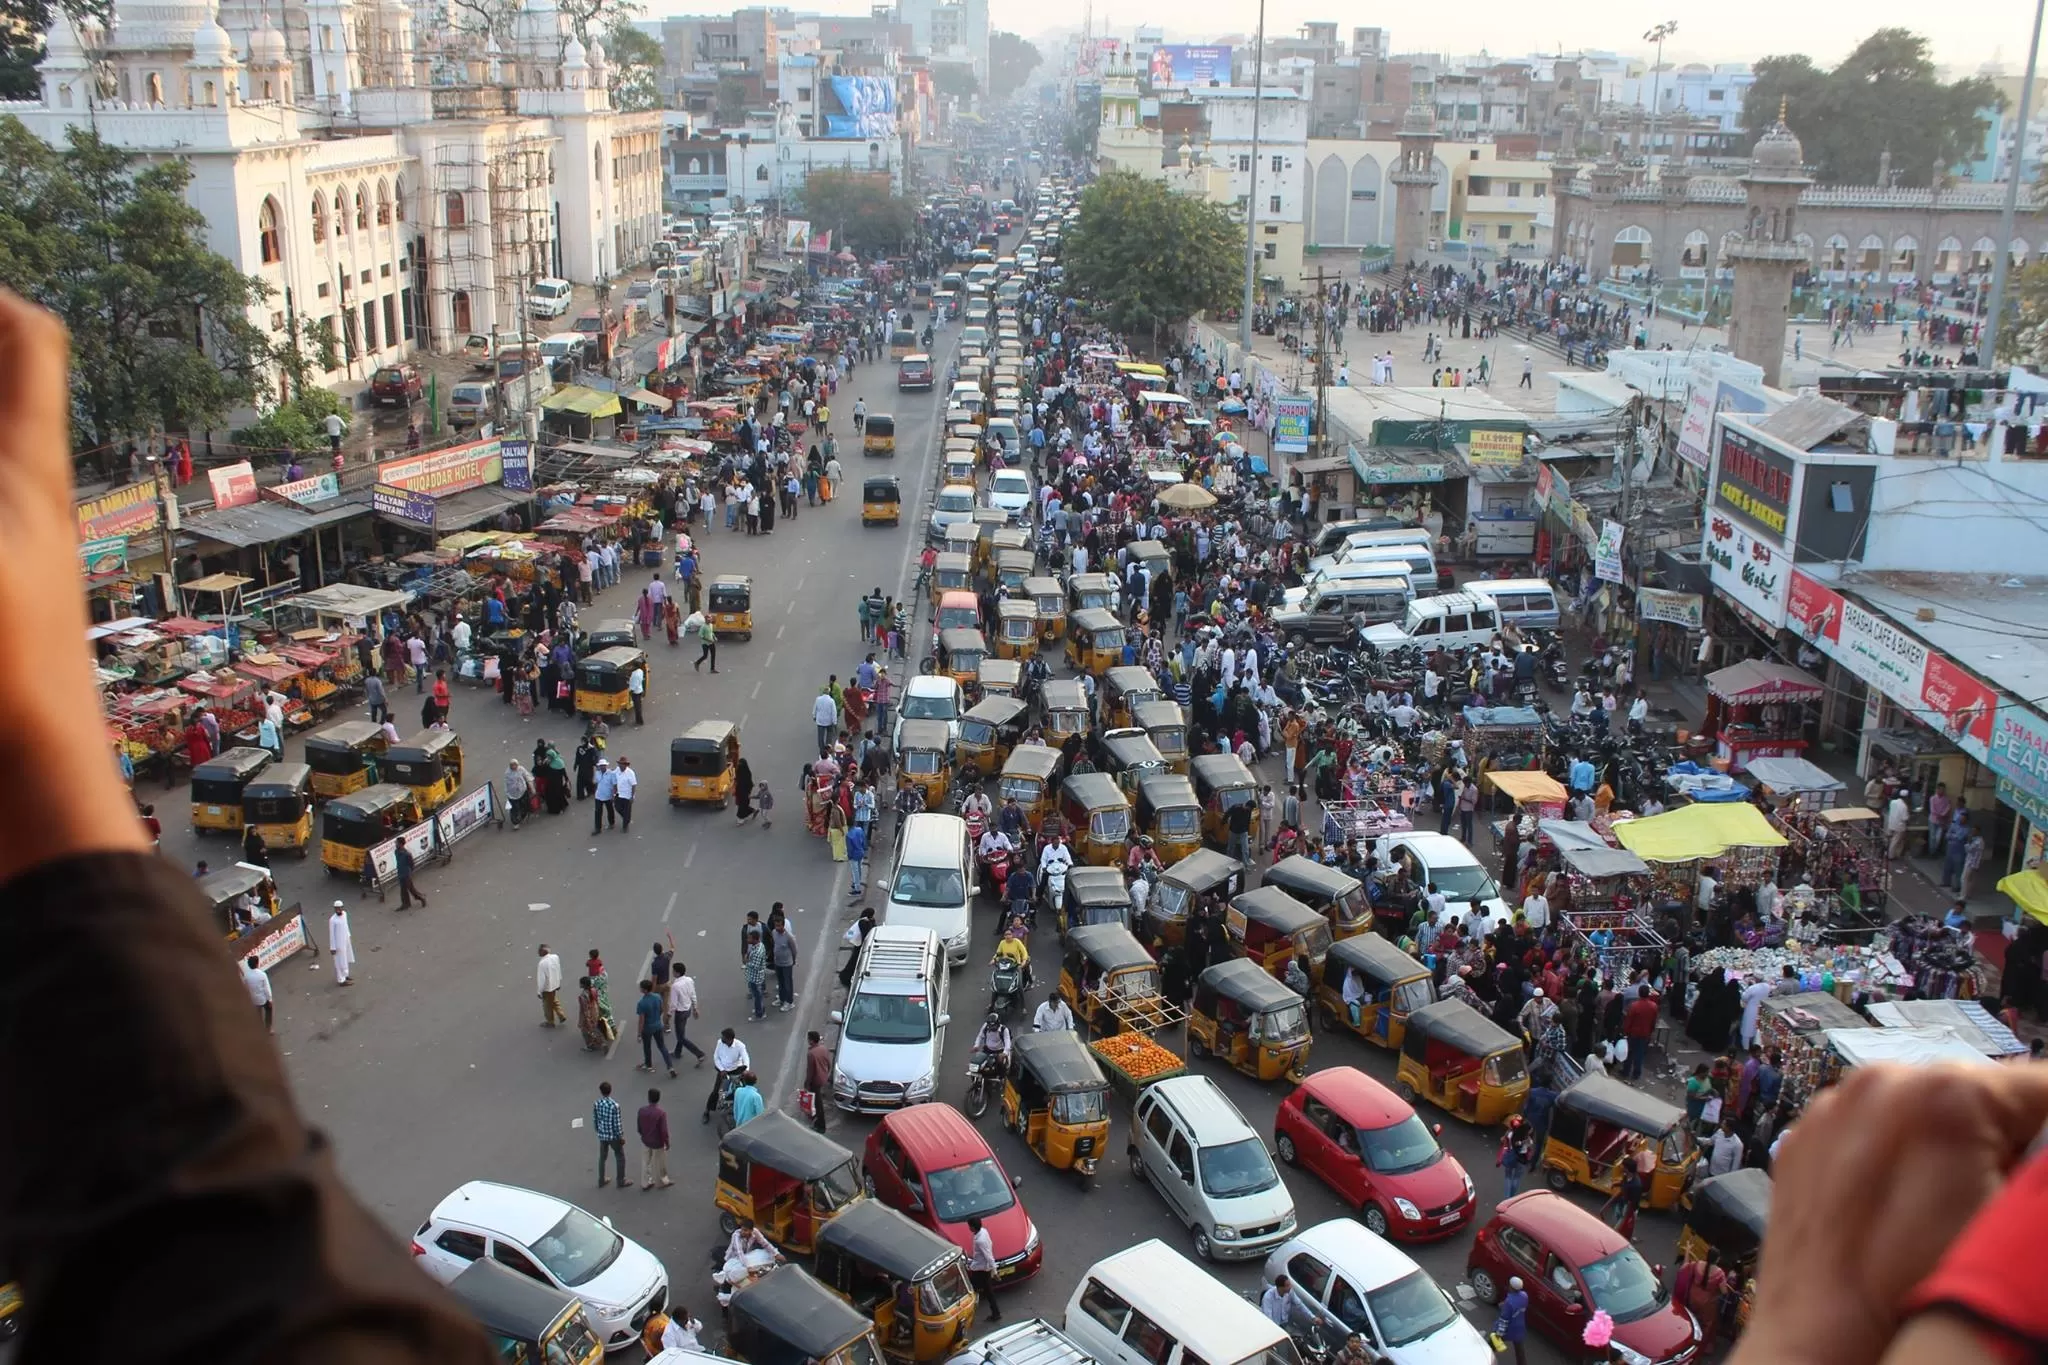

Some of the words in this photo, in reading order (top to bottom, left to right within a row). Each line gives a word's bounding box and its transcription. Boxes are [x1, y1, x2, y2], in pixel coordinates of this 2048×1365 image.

[501, 446, 527, 457] KALYANI
[503, 458, 527, 468] BIRYANI
[1723, 441, 1792, 505] NIMRAH
[406, 469, 452, 491] MUQADDAR
[455, 462, 481, 479] HOTEL
[291, 486, 319, 499] SHOP
[373, 493, 406, 508] KALYANI
[374, 501, 405, 517] BIRYANI
[1751, 498, 1786, 533] BAKERY
[1845, 605, 1873, 637] FARASHA
[1874, 622, 1892, 648] CAFE
[1897, 638, 1926, 668] BAKERY
[1926, 685, 1951, 712] Coca-Cola
